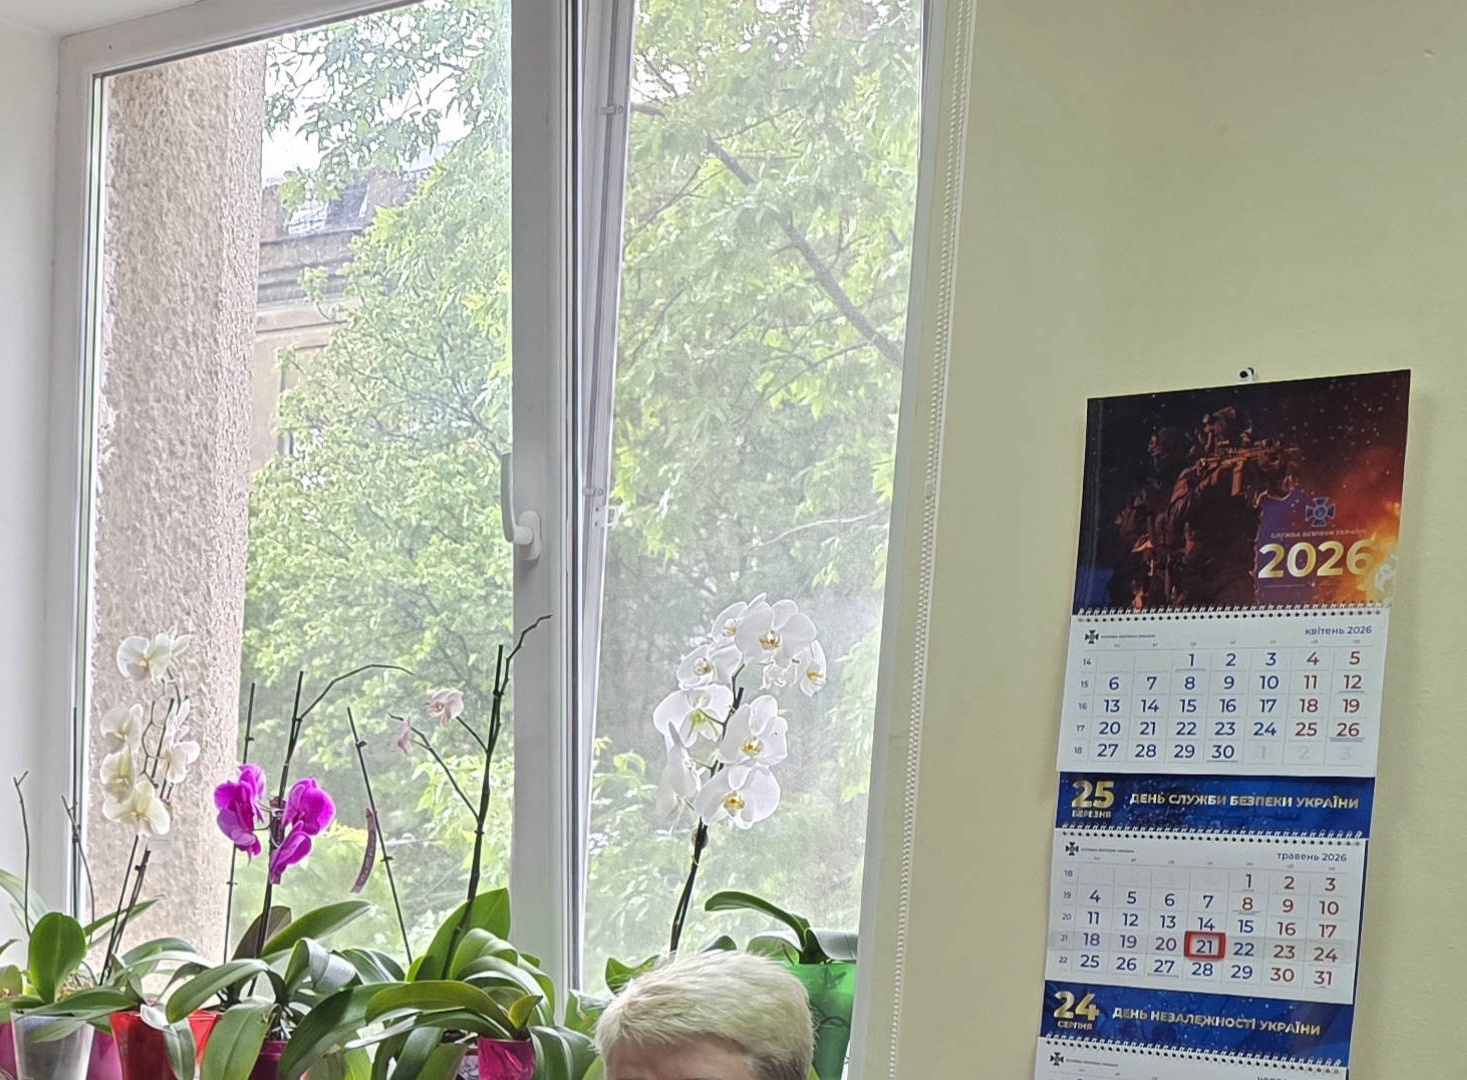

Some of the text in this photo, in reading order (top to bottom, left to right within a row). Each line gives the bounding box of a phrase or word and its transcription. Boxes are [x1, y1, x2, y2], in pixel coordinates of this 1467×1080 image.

[1257, 539, 1376, 579] 2026
[1305, 625, 1372, 636] квітень 2026
[1189, 654, 1194, 667] 1
[1225, 653, 1236, 666] 2
[1266, 652, 1276, 666] 3
[1307, 652, 1319, 665] 4
[1349, 651, 1360, 665] 5
[1109, 677, 1119, 690] 6
[1147, 676, 1157, 690] 7
[1184, 676, 1195, 690] 8
[1224, 676, 1234, 689] 9
[1260, 676, 1279, 689] 10
[1304, 675, 1317, 689] 11
[1344, 675, 1361, 689] 12
[1104, 699, 1360, 713] 13 14 15 16 17 18 19
[1099, 722, 1120, 734] 20
[1140, 722, 1155, 735] 21
[1176, 722, 1196, 735] 22
[1215, 722, 1235, 735] 23
[1253, 722, 1277, 736] 24
[1295, 722, 1317, 736] 25
[1337, 723, 1359, 737] 26
[1097, 744, 1234, 758] 27 28 29 30
[1071, 780, 1115, 809] 25
[1129, 793, 1360, 809] ДЕНЬ СЛУЖБИ БЕЗПЕКИ УКРАЇНИ
[1072, 810, 1111, 819] БЕРЕЗНЯ
[1277, 852, 1347, 862] травень 2026
[1246, 874, 1251, 888] 1
[1284, 876, 1294, 890] 2
[1325, 878, 1335, 891] 3
[1090, 890, 1100, 903] 4
[1127, 891, 1136, 904] 5
[1165, 893, 1174, 906] 6
[1203, 895, 1213, 908] 7
[1242, 897, 1253, 911] 8
[1283, 899, 1293, 913] 9
[1319, 901, 1339, 915] 10
[1088, 911, 1099, 924] 11
[1123, 913, 1138, 926] 12
[1160, 915, 1176, 928] 13
[1198, 917, 1215, 931] 14
[1238, 920, 1253, 933] 15
[1277, 922, 1296, 936] 16
[1319, 924, 1337, 938] 17
[1083, 933, 1338, 962] 18 19 20 21 22 23 24
[1080, 954, 1099, 968] 25
[1116, 957, 1136, 971] 26
[1154, 959, 1175, 973] 27
[1191, 962, 1213, 976] 28
[1231, 965, 1253, 979] 29
[1270, 967, 1294, 982] 30
[1314, 971, 1332, 985] 31
[1053, 991, 1099, 1022] 24
[1057, 1021, 1093, 1030] СЕРПНЯ
[1112, 1007, 1321, 1036] ДЕНЬ НЕЗАЛЕЖНОСТІ УКРАЇНИ
